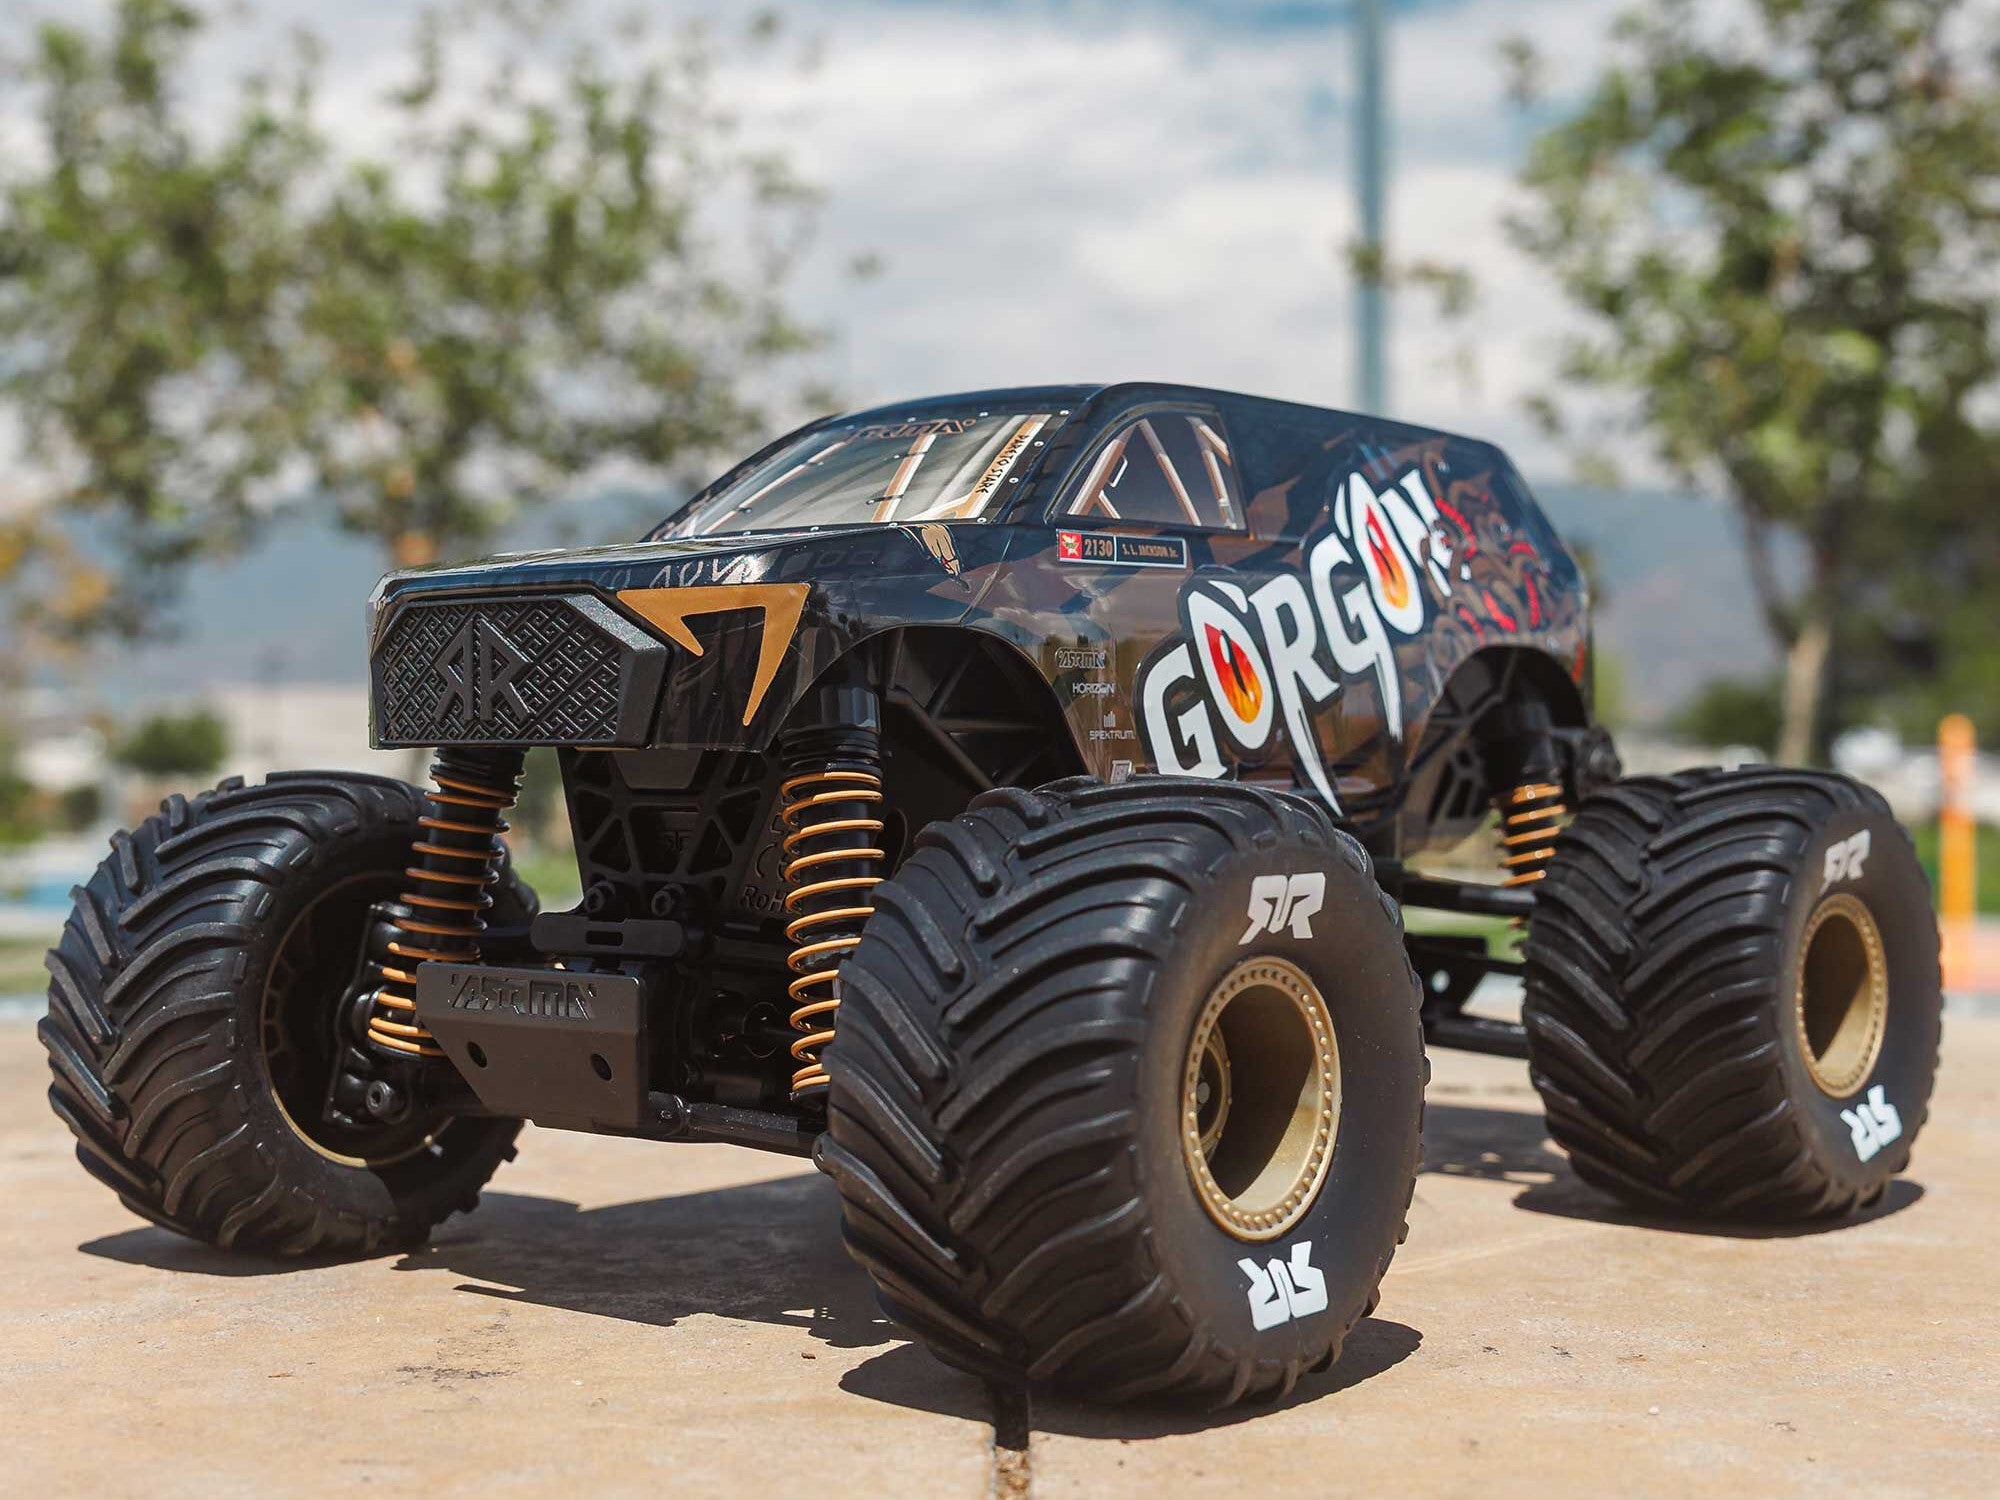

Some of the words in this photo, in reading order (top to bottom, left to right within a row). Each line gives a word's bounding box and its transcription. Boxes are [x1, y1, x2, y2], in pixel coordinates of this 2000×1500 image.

[1084, 538, 1113, 557] 2130
[1143, 468, 1470, 816] GORGON
[1072, 682, 1115, 695] HORIZON
[1089, 730, 1135, 740] SPEKTRUM
[740, 885, 790, 914] RoH
